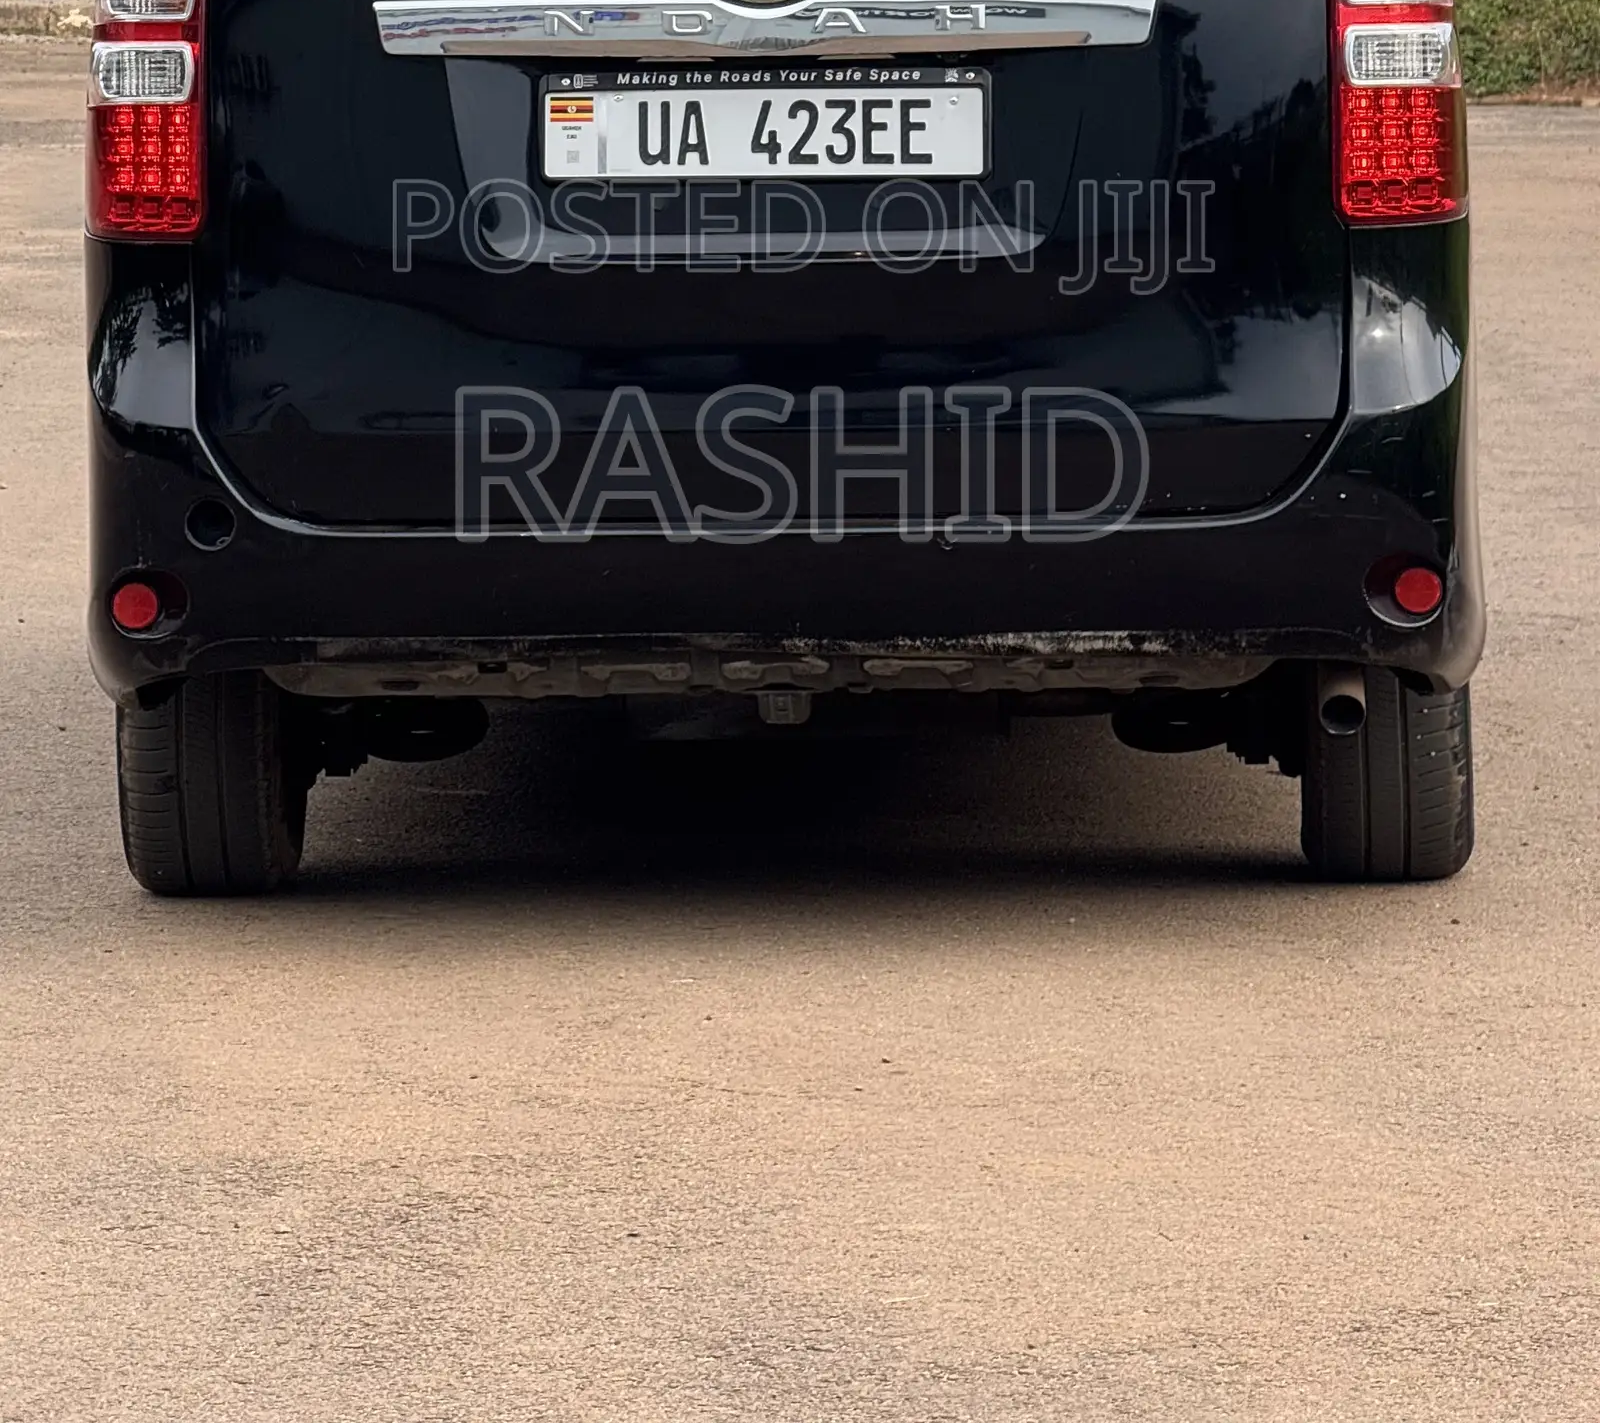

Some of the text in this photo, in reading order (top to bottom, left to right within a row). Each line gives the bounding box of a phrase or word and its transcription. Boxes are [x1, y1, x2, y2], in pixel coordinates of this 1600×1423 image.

[543, 3, 987, 36] NOAH
[617, 68, 921, 86] Making the Roads Your Safe Space
[637, 98, 933, 166] UA 423EE
